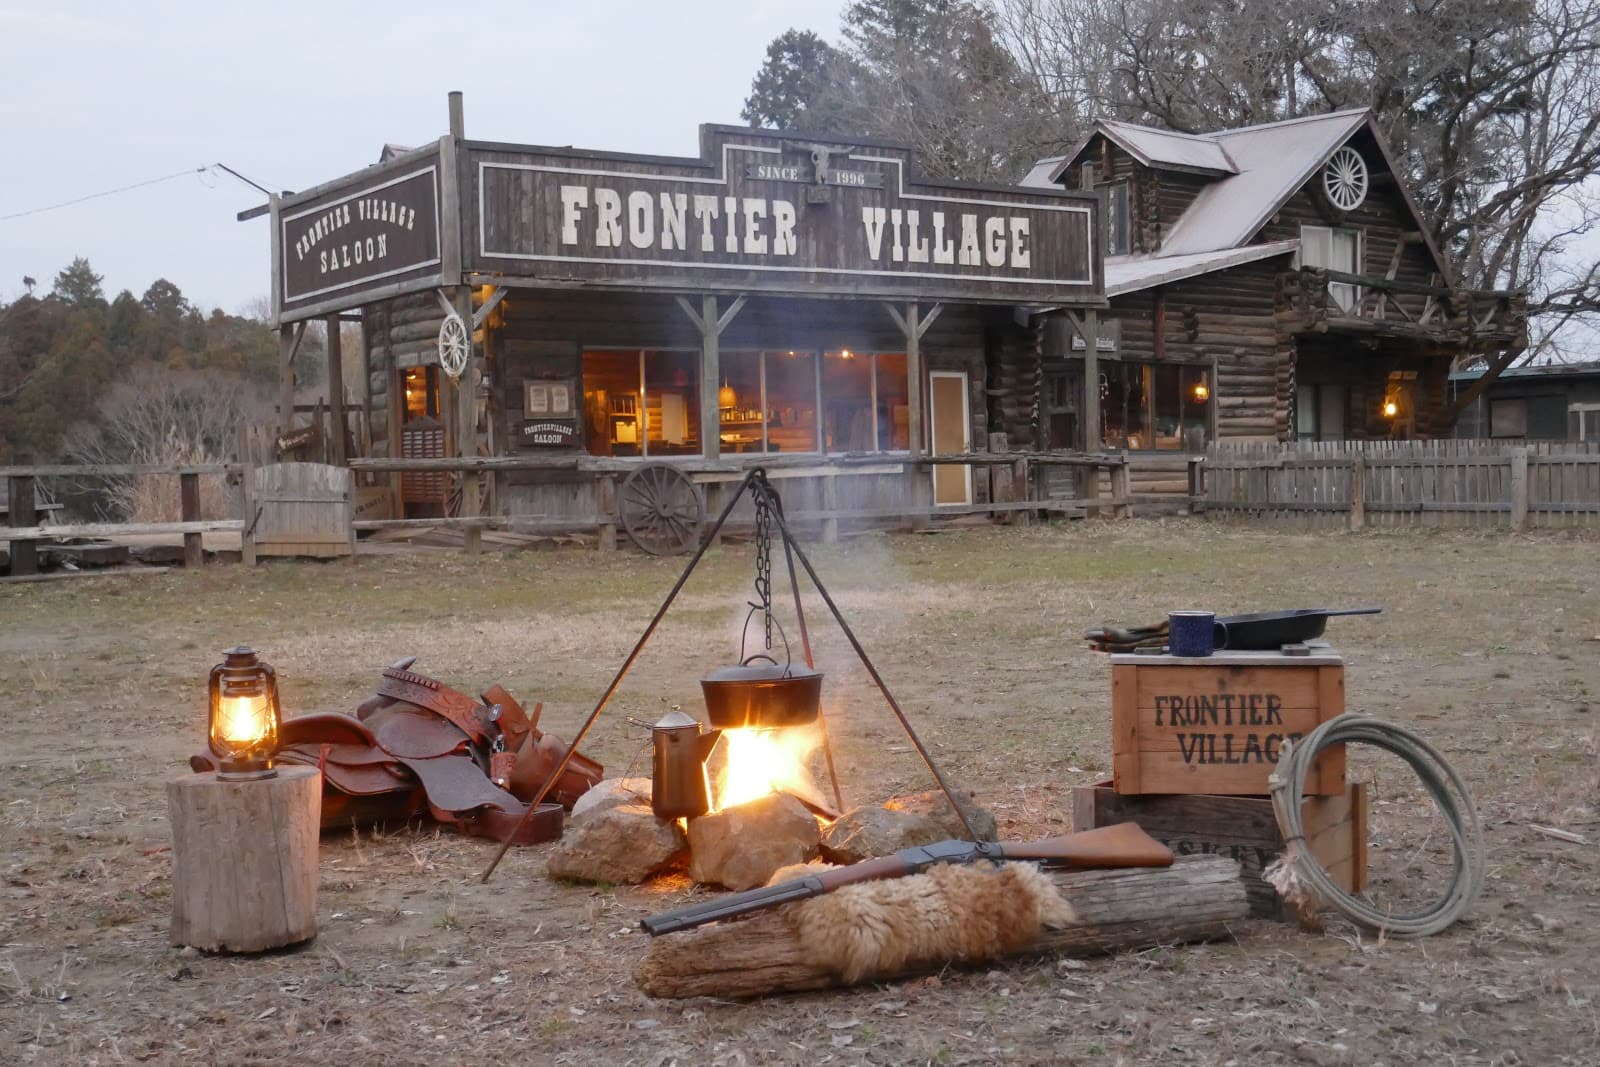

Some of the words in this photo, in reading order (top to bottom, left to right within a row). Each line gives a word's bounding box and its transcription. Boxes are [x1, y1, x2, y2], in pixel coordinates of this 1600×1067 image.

[758, 165, 798, 181] SINCE
[834, 171, 865, 185] 1996
[296, 204, 350, 261] FRONTIER
[359, 199, 415, 230] VILLAGE
[560, 185, 797, 256] FRONTIER
[861, 206, 1031, 268] VILLAGE
[320, 234, 387, 274] SALOON
[534, 433, 563, 444] SALOON
[1154, 694, 1282, 726] FRONTIER
